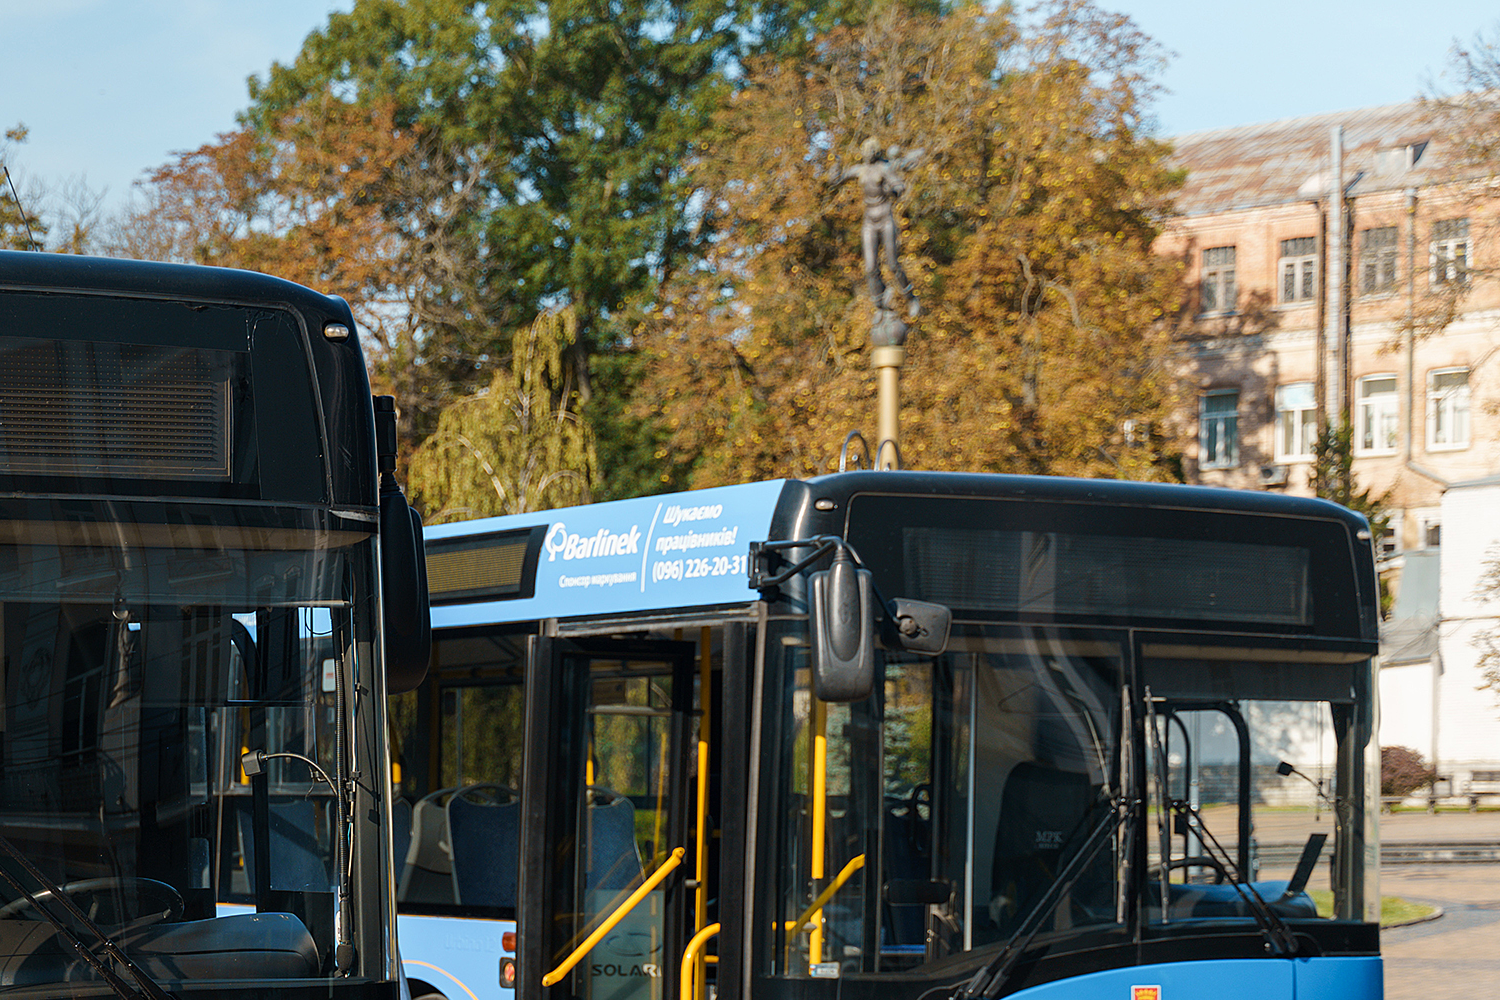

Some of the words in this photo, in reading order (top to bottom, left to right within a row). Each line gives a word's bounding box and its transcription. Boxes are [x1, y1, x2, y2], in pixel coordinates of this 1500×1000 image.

[662, 504, 723, 527] Шукаємо
[563, 524, 642, 560] Barlinek
[655, 526, 739, 555] працівників!
[652, 558, 684, 583] (096)
[684, 554, 747, 578] 226-20-31
